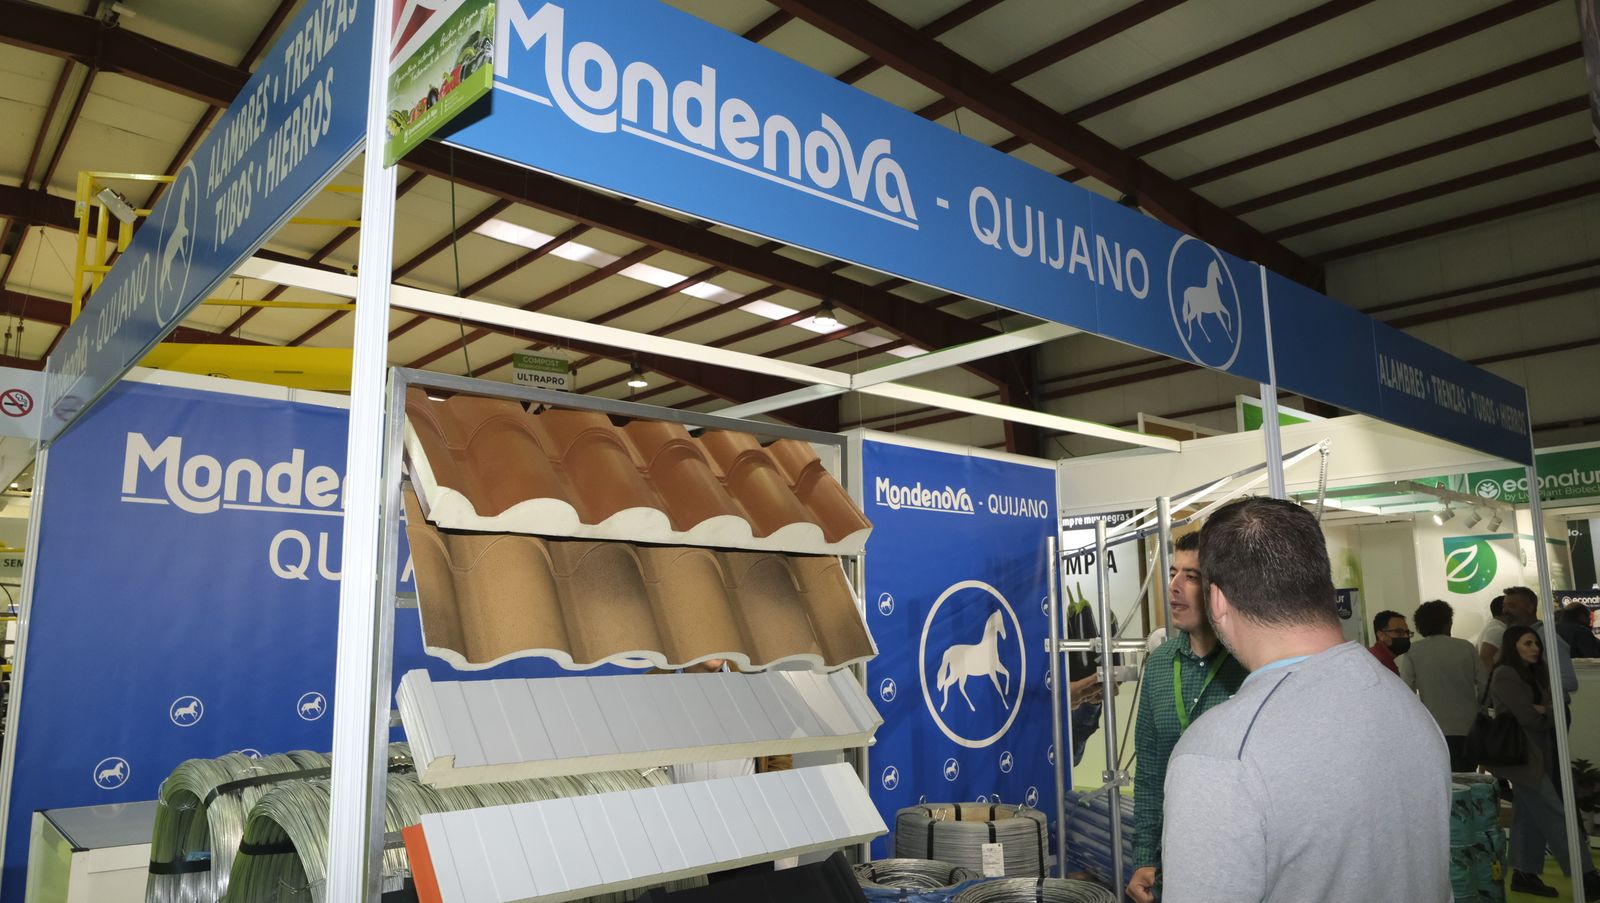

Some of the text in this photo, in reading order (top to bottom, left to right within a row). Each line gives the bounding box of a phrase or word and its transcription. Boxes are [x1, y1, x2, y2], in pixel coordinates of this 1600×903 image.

[206, 73, 270, 200] ALAMBRES
[214, 66, 334, 252] TUBOS HIERROS
[969, 186, 1150, 300] QUIJANO
[96, 253, 150, 352] QUIJANO
[517, 372, 565, 386] ULTRAPRO
[522, 356, 560, 367] COMPOST
[1379, 353, 1426, 400] ALAMBRES
[1431, 375, 1467, 415] TRENZAS
[1471, 391, 1497, 425] TUBOS
[122, 432, 347, 515] Monde
[988, 494, 1049, 520] QUIJANO
[1504, 493, 1516, 503] by
[1102, 513, 1130, 525] negras
